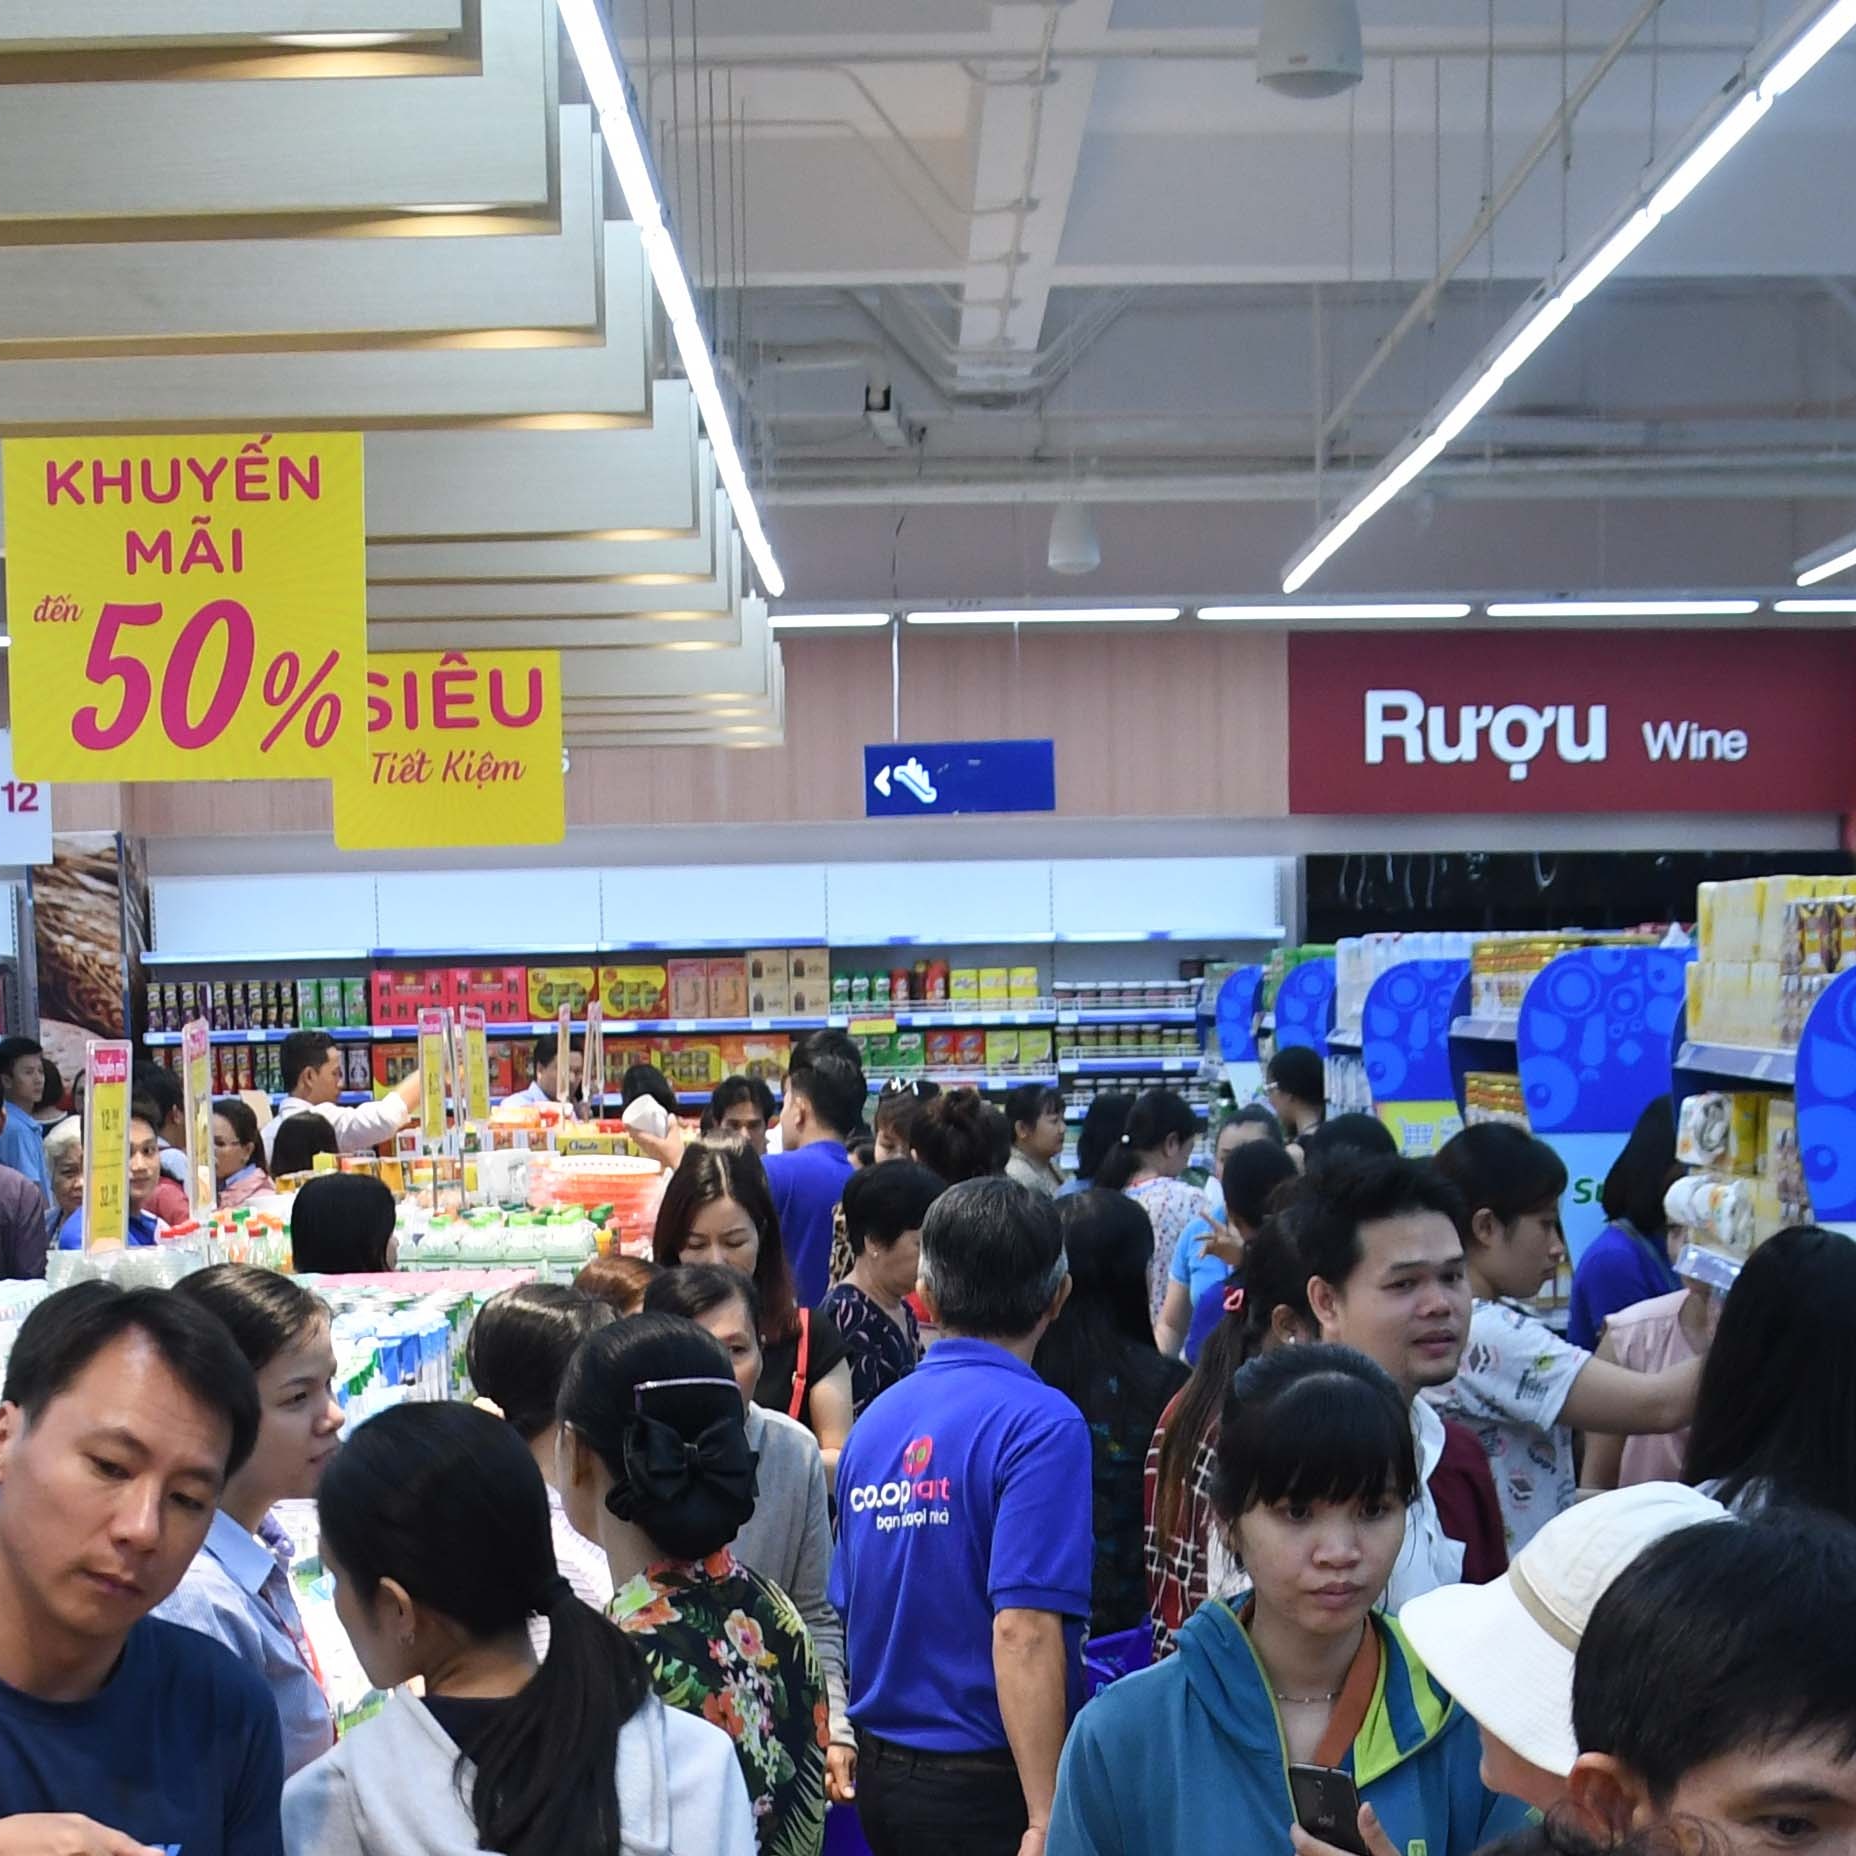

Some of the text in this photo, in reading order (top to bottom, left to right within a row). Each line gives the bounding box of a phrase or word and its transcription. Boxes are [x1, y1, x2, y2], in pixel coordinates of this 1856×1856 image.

[46, 432, 320, 505] KHUYẾN
[125, 517, 244, 575] MÃI
[33, 594, 341, 753] đến 50%
[368, 651, 542, 732] SIÊU
[373, 750, 431, 786] Tiết
[441, 749, 525, 790] Kiệm
[1363, 689, 1748, 780] Rượu Wine
[1, 782, 40, 813] 12
